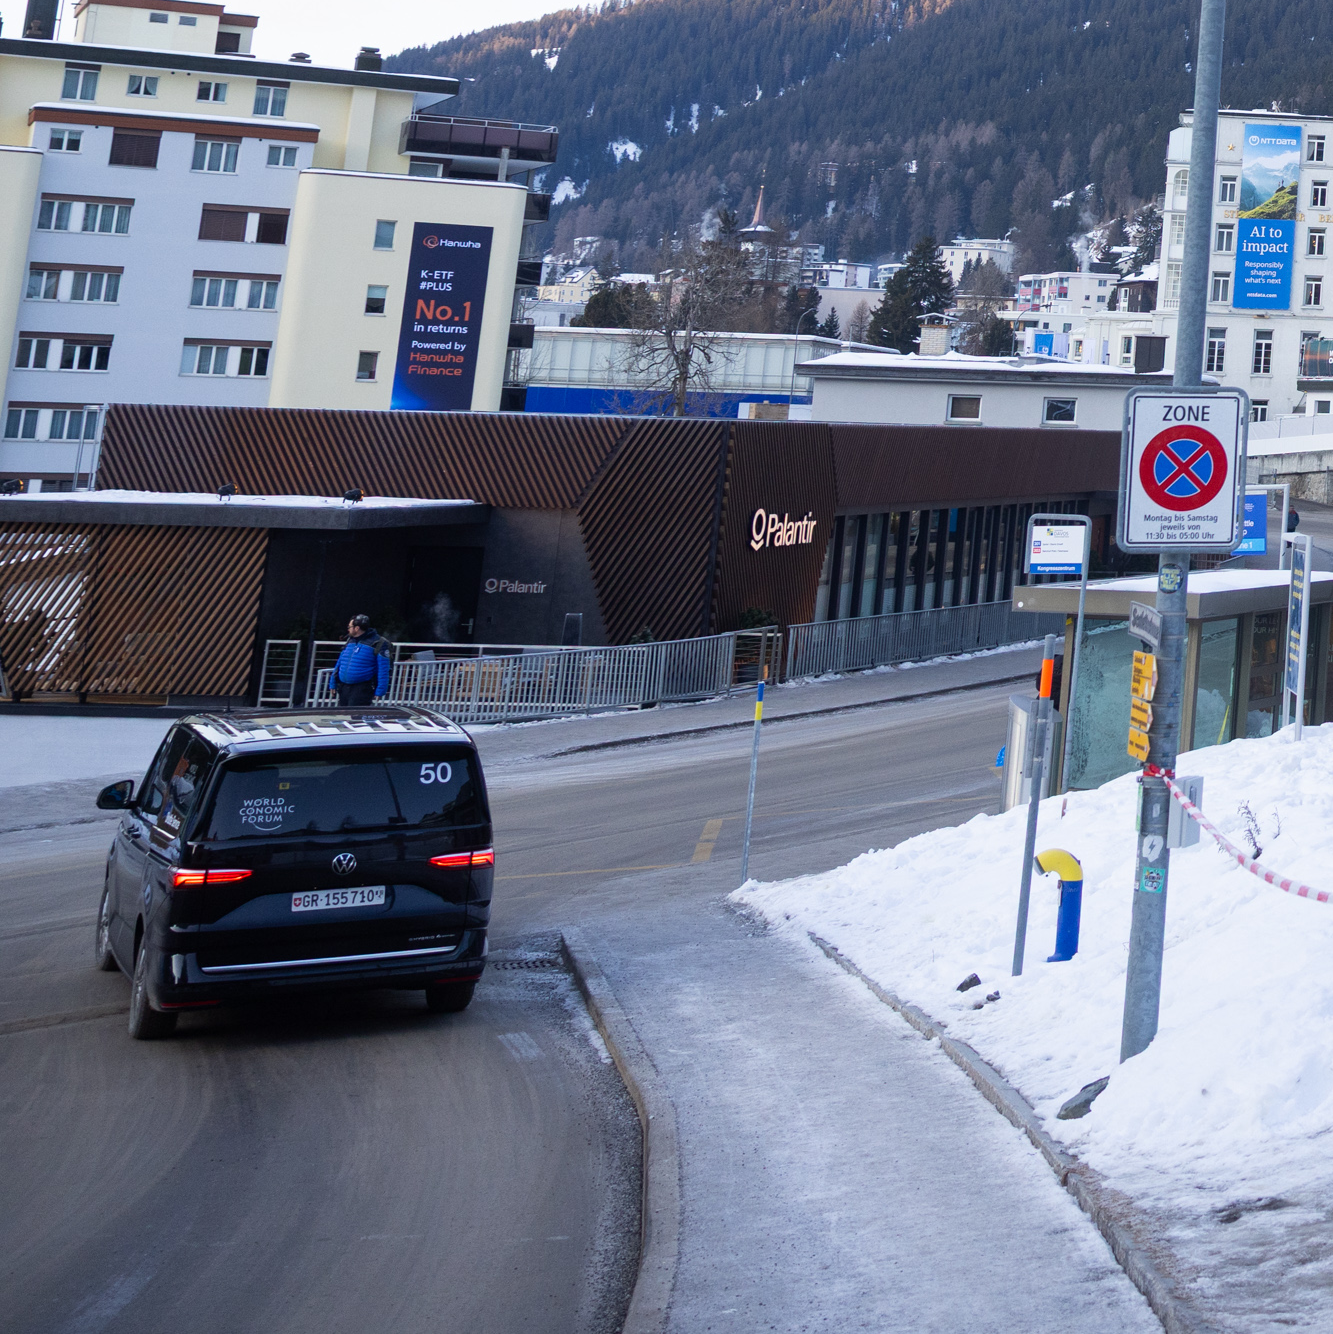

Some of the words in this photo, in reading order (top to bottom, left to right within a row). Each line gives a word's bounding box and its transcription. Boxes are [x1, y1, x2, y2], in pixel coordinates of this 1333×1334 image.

[1250, 226, 1265, 238] AI
[1269, 227, 1283, 238] to
[439, 238, 482, 249] Hanwha
[1242, 240, 1289, 255] impact
[1244, 260, 1284, 270] Responsibly
[420, 269, 455, 279] K-ETF
[1250, 269, 1277, 277] shaping
[419, 281, 453, 291] #PLUS
[415, 299, 471, 321] No.1
[413, 322, 425, 332] in
[427, 323, 468, 334] returns
[411, 340, 451, 350] Powered
[454, 341, 466, 351] by
[410, 352, 464, 363] Hanwha
[408, 365, 462, 376] Finance
[1162, 405, 1210, 422] ZONE
[1143, 514, 1173, 524] Montag
[1174, 514, 1185, 522] bis
[1187, 514, 1218, 524] Samstag
[765, 511, 817, 548] Palantir
[1160, 523, 1185, 532] jeweils
[1145, 532, 1165, 540] 11:30
[1179, 532, 1200, 540] 05:00
[499, 579, 547, 594] Palantir
[419, 762, 453, 785] 50
[243, 797, 286, 807] WORLD
[241, 814, 283, 824] FORUM
